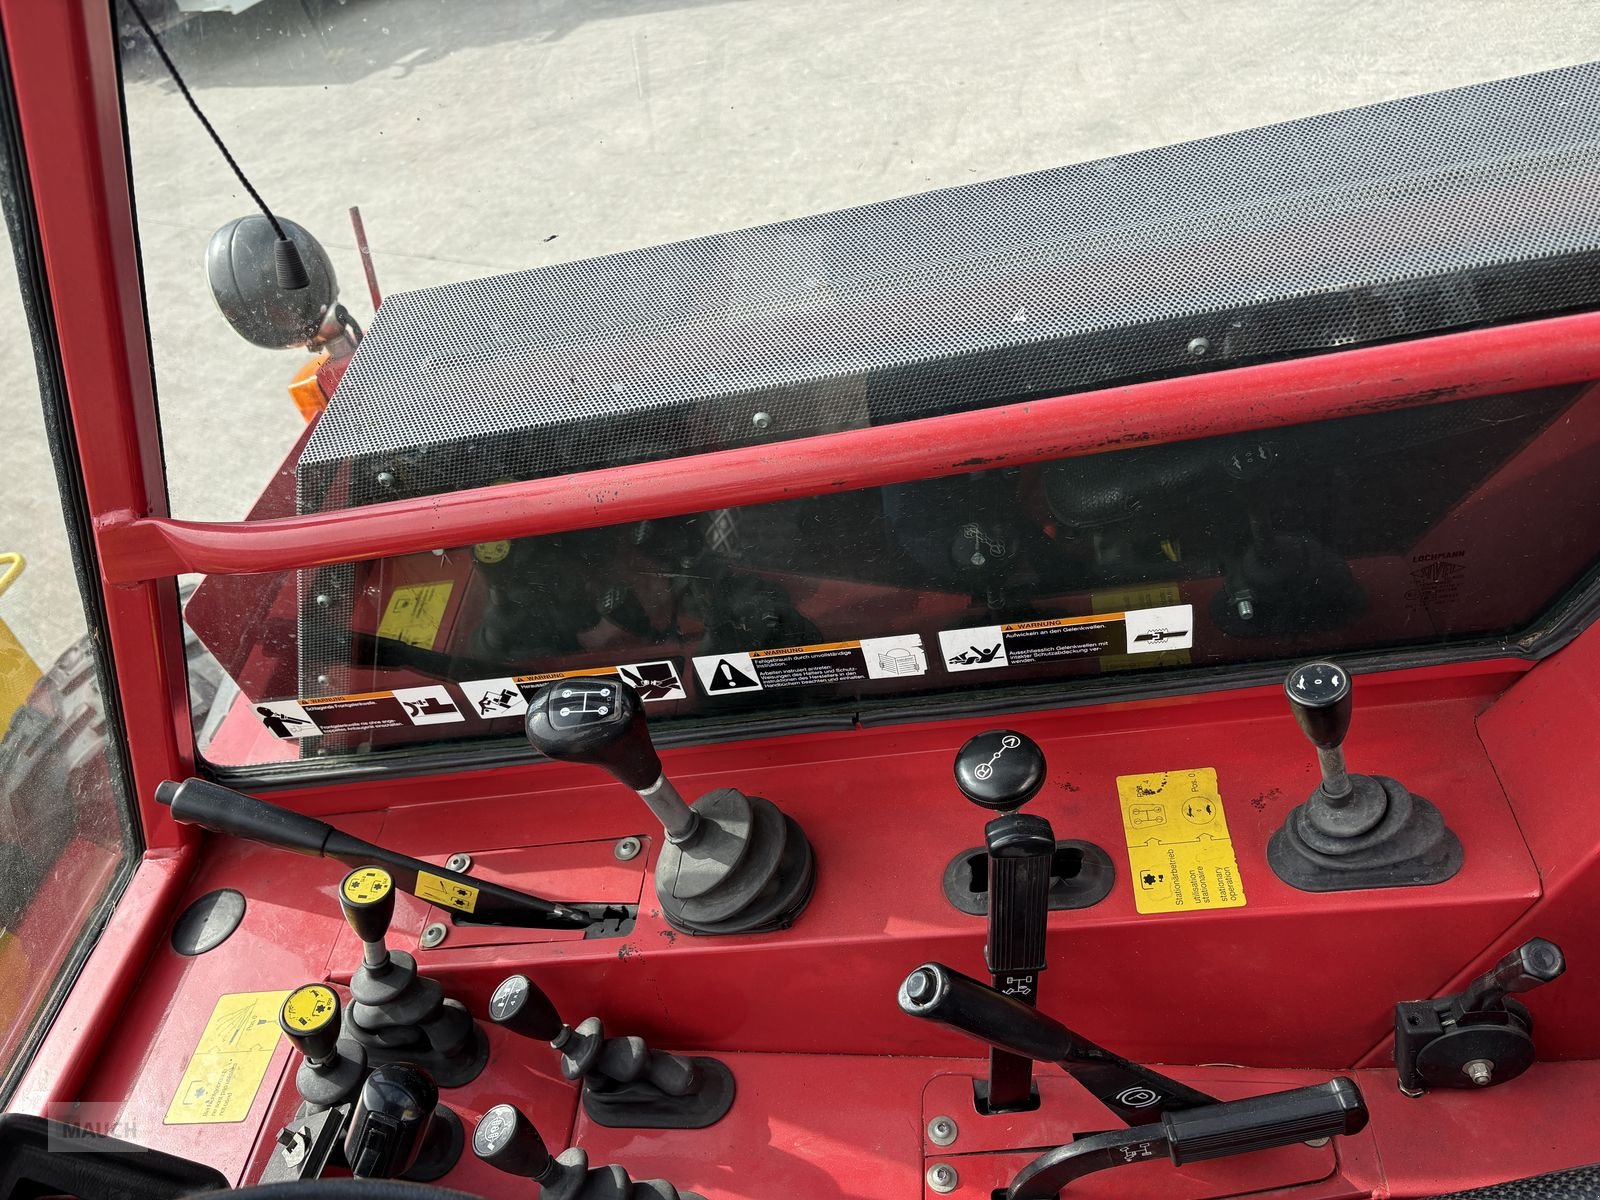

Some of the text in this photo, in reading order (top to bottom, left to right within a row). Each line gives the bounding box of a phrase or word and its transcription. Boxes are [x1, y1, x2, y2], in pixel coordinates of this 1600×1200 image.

[1412, 551, 1465, 562] LOCHMANN
[1017, 620, 1062, 629] WARNUNG
[1062, 624, 1107, 632] Gelenkwellen.
[763, 648, 804, 656] WARNUNG
[1009, 646, 1055, 656] Ausschliesslich
[1056, 642, 1097, 651] Gelenkwellen
[1033, 649, 1089, 658] Schutzabdeckung
[526, 673, 565, 682] WARNUNG
[310, 696, 346, 704] WARNUNG
[976, 765, 990, 778] R
[1168, 849, 1184, 906] Stationärbetrieb
[1189, 870, 1202, 904] utilisation
[1216, 866, 1228, 902] stationary
[1224, 866, 1237, 901] operation
